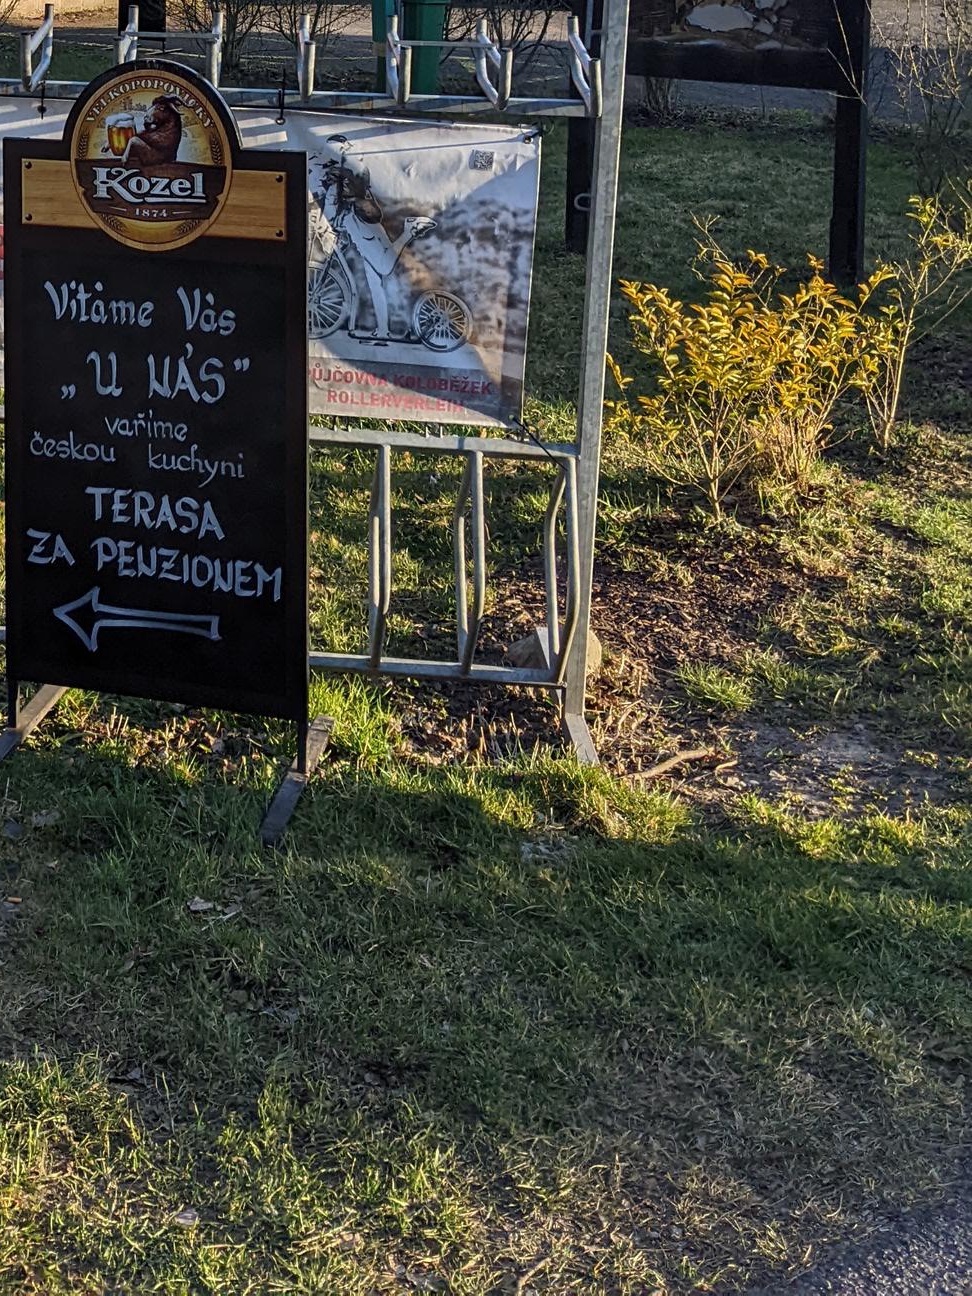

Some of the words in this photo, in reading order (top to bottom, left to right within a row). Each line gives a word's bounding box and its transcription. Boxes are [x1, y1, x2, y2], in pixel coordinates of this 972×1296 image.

[92, 167, 207, 203] Kozel
[135, 207, 168, 217] 1874
[308, 362, 388, 387] ŮJČOVNA
[393, 374, 493, 396] KOLOBĚŽEK
[326, 389, 465, 413] ROLLERVERLEIH
[29, 429, 117, 462] českou
[84, 486, 226, 541] TERASA
[26, 528, 76, 567] ZA
[90, 536, 283, 602] PENZIONEM
